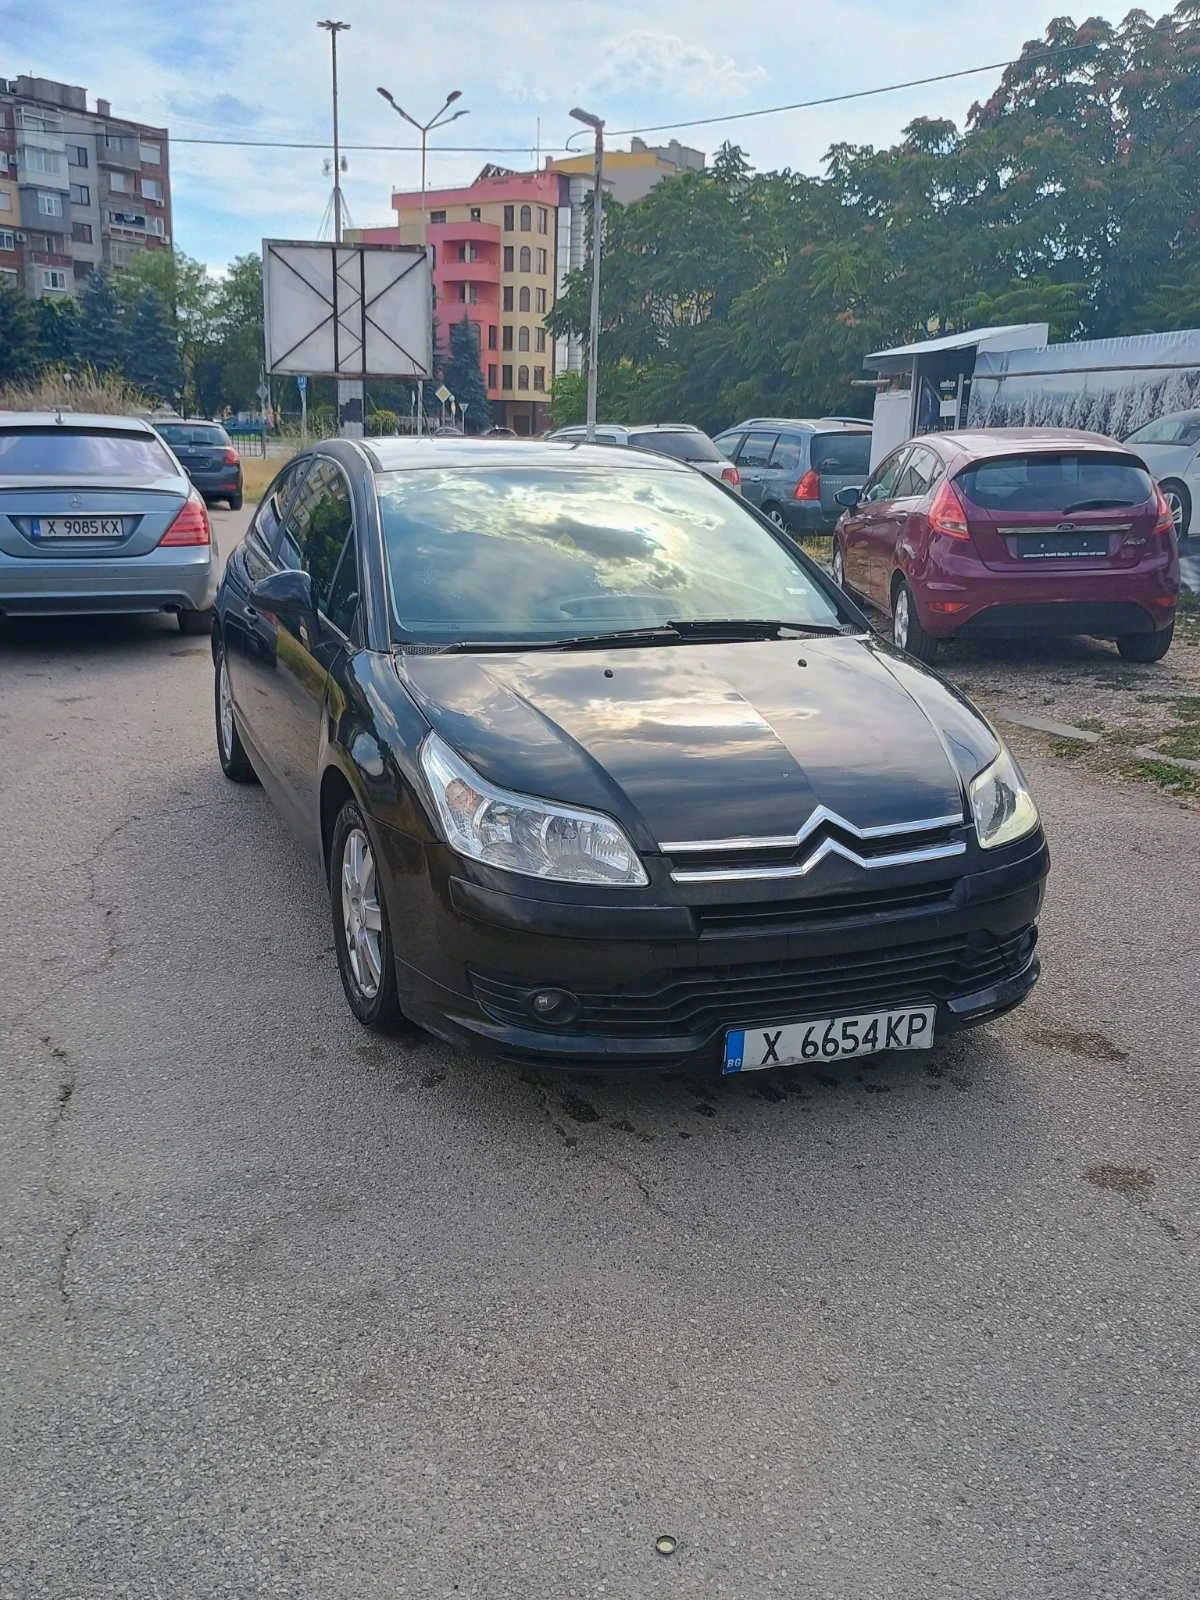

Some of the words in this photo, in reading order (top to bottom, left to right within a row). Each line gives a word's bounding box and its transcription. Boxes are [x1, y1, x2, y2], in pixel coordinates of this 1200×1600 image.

[47, 520, 57, 534] X
[761, 1031, 782, 1064] X
[726, 1058, 741, 1068] BG
